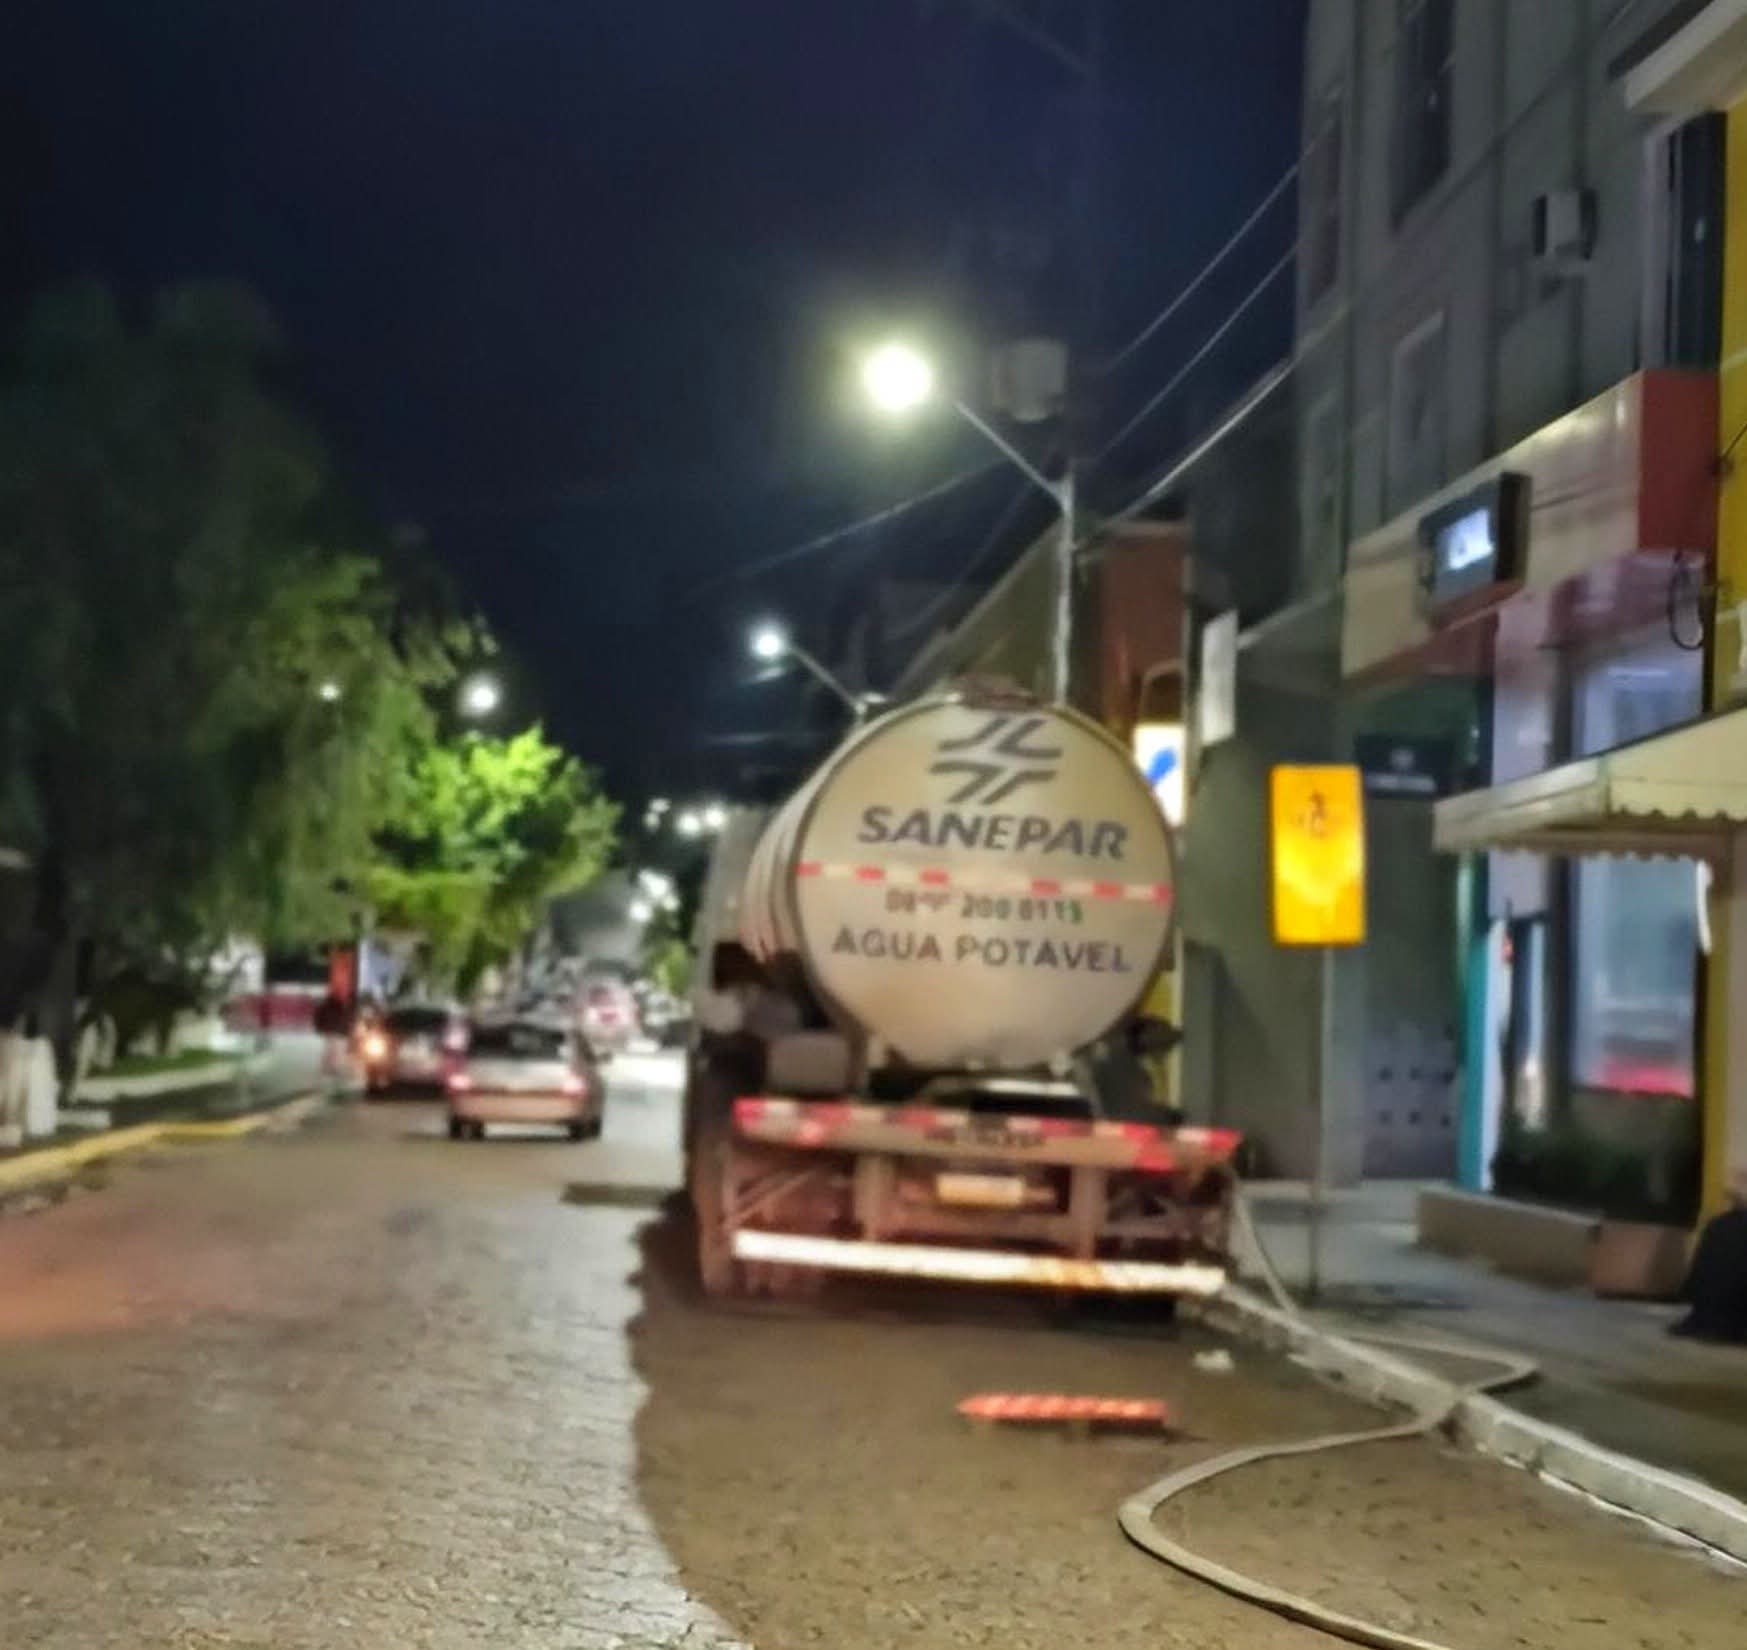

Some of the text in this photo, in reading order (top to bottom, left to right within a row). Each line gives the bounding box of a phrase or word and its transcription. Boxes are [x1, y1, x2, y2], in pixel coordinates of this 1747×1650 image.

[857, 805, 1129, 860] SANEPAR
[832, 925, 1133, 973] AGUA POTAVEL
